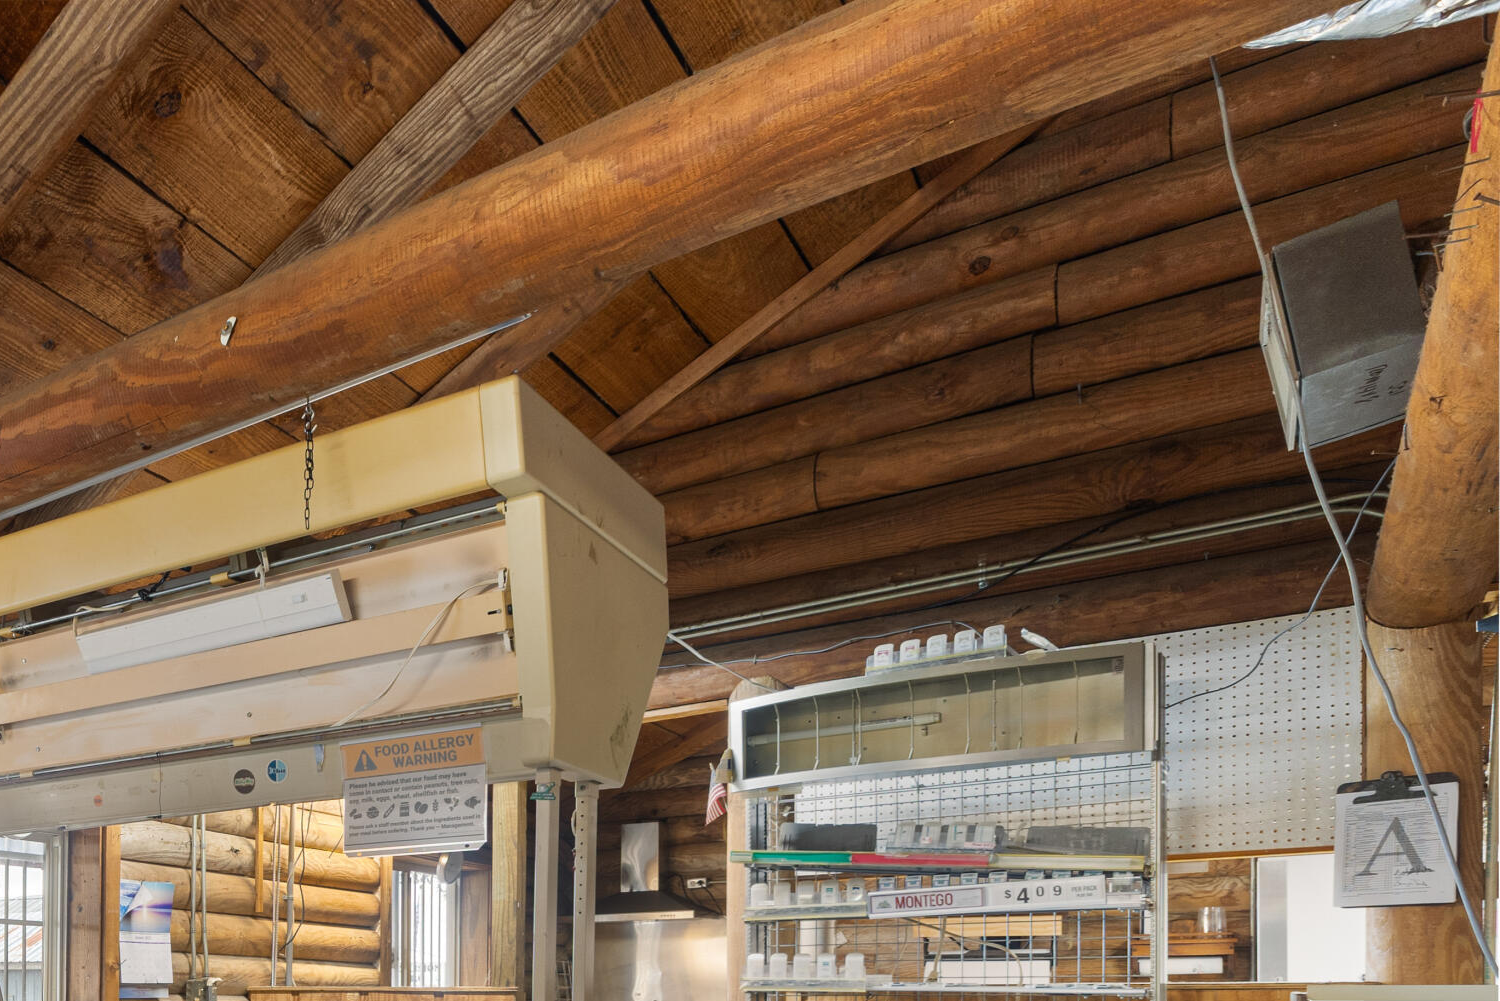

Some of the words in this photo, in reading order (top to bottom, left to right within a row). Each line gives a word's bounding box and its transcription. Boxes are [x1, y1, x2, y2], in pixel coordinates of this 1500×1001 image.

[374, 743, 410, 758] FOOD
[413, 734, 474, 753] ALLERGY
[393, 750, 458, 768] WARNING
[1354, 817, 1434, 876] A
[895, 893, 953, 910] MONTEGO
